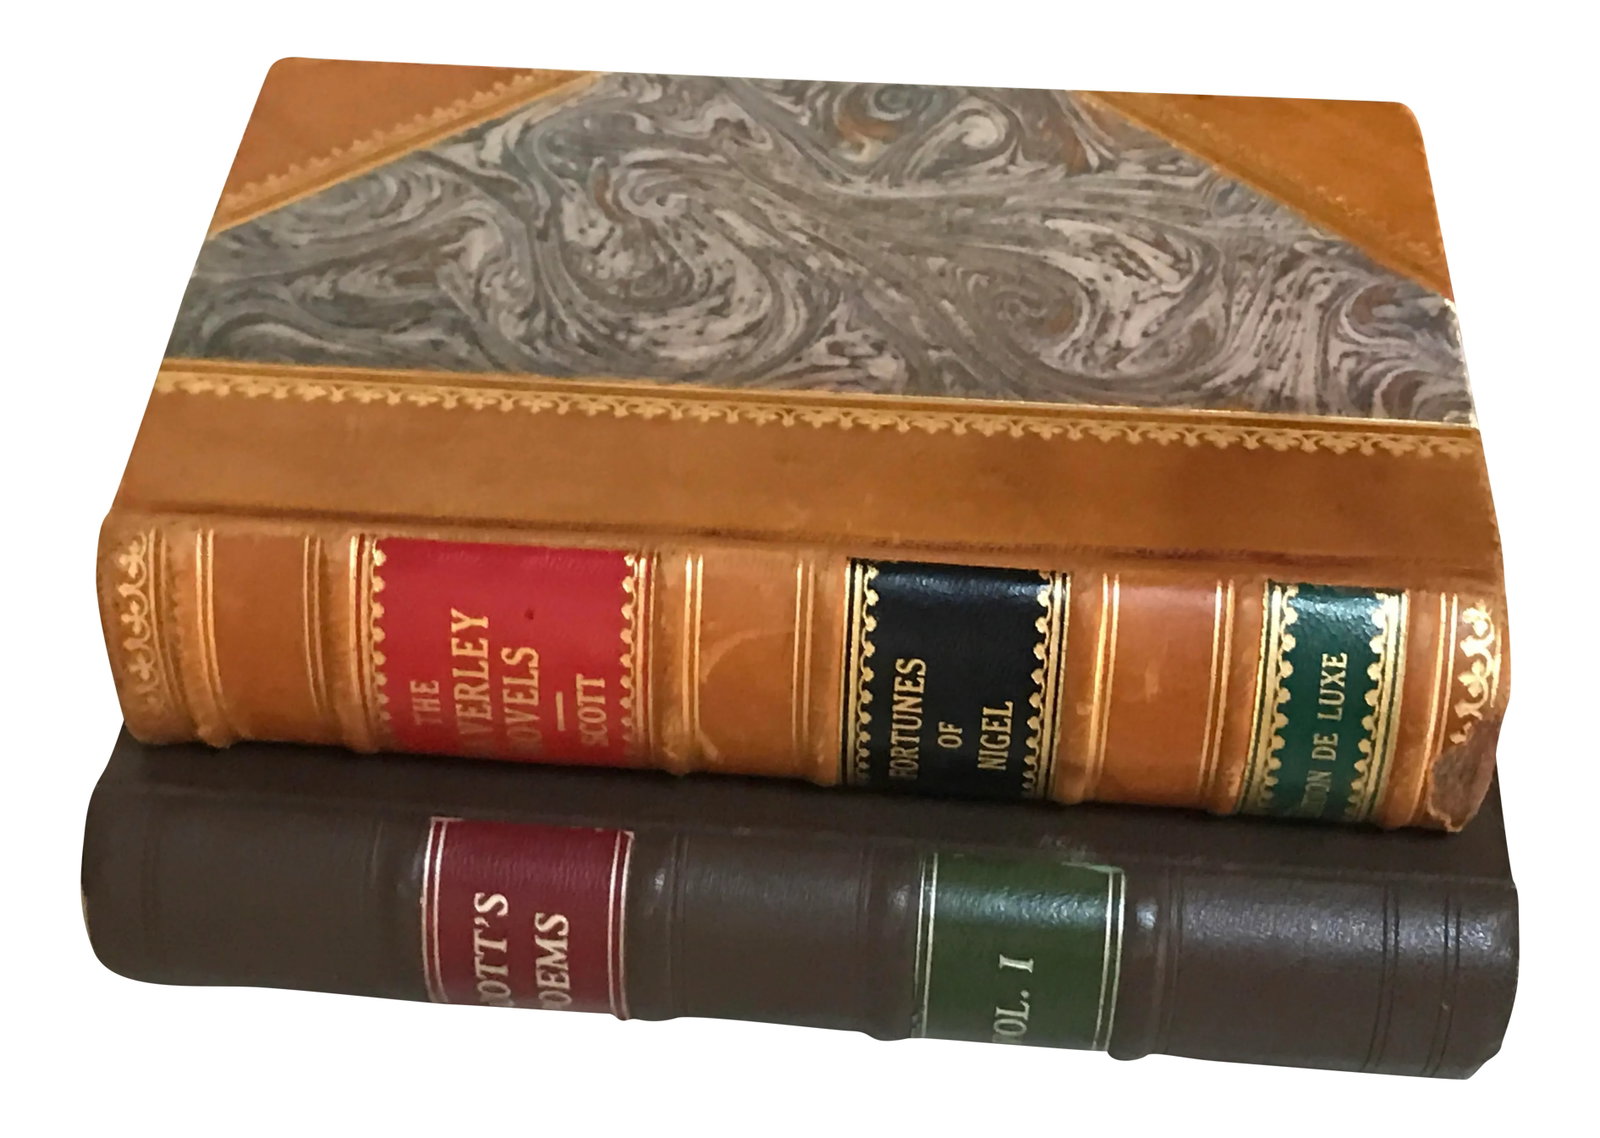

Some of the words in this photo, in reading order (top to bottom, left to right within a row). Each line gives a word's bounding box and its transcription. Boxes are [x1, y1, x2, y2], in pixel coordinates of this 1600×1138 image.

[409, 679, 443, 726] THE
[1317, 652, 1349, 721] LUXE
[937, 721, 963, 749] OF
[977, 700, 1014, 771] NIGEL
[1312, 733, 1339, 761] DE
[534, 912, 572, 1009] OEMS
[998, 953, 1035, 974] I
